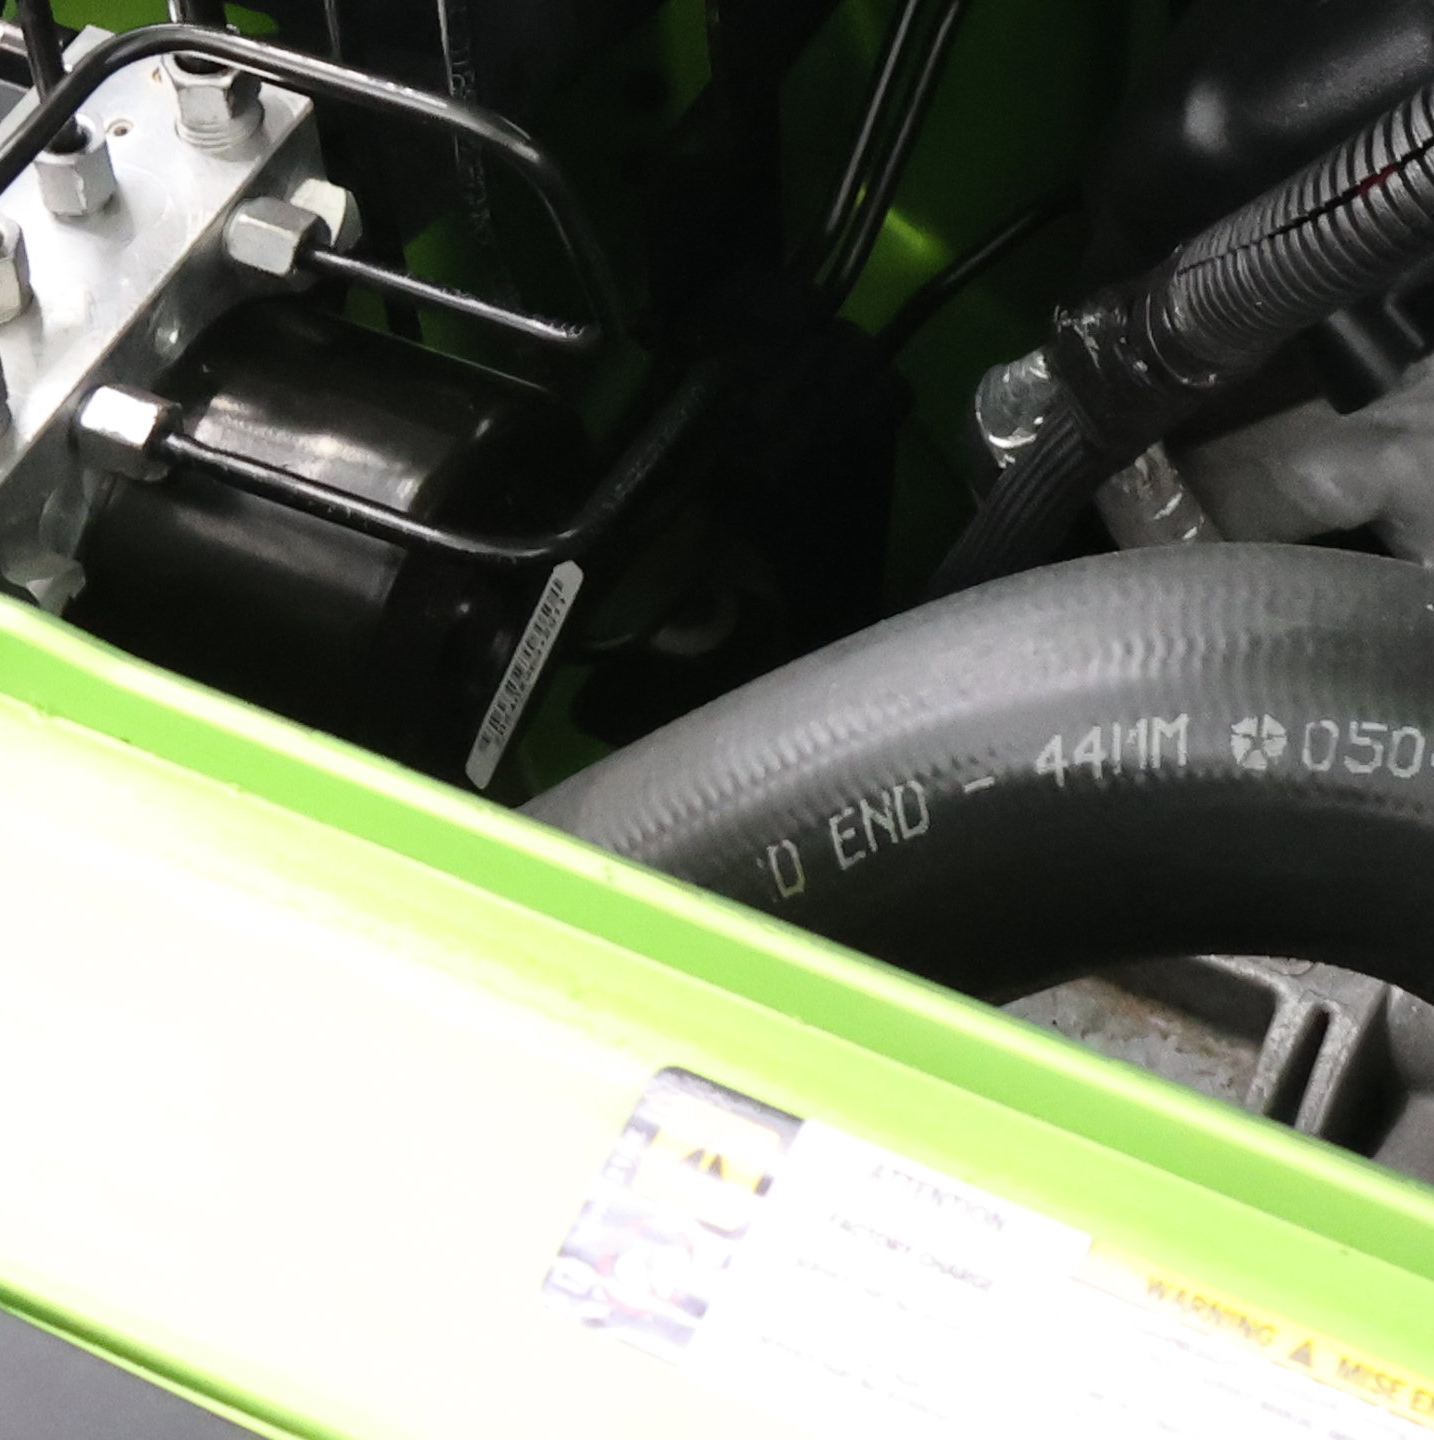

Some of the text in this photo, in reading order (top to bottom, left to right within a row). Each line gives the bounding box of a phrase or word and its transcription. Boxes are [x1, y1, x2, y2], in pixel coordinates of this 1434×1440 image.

[757, 842, 805, 904] D
[830, 779, 930, 877] END
[1035, 713, 1190, 782] 44MM
[1146, 1276, 1278, 1347] WARNING
